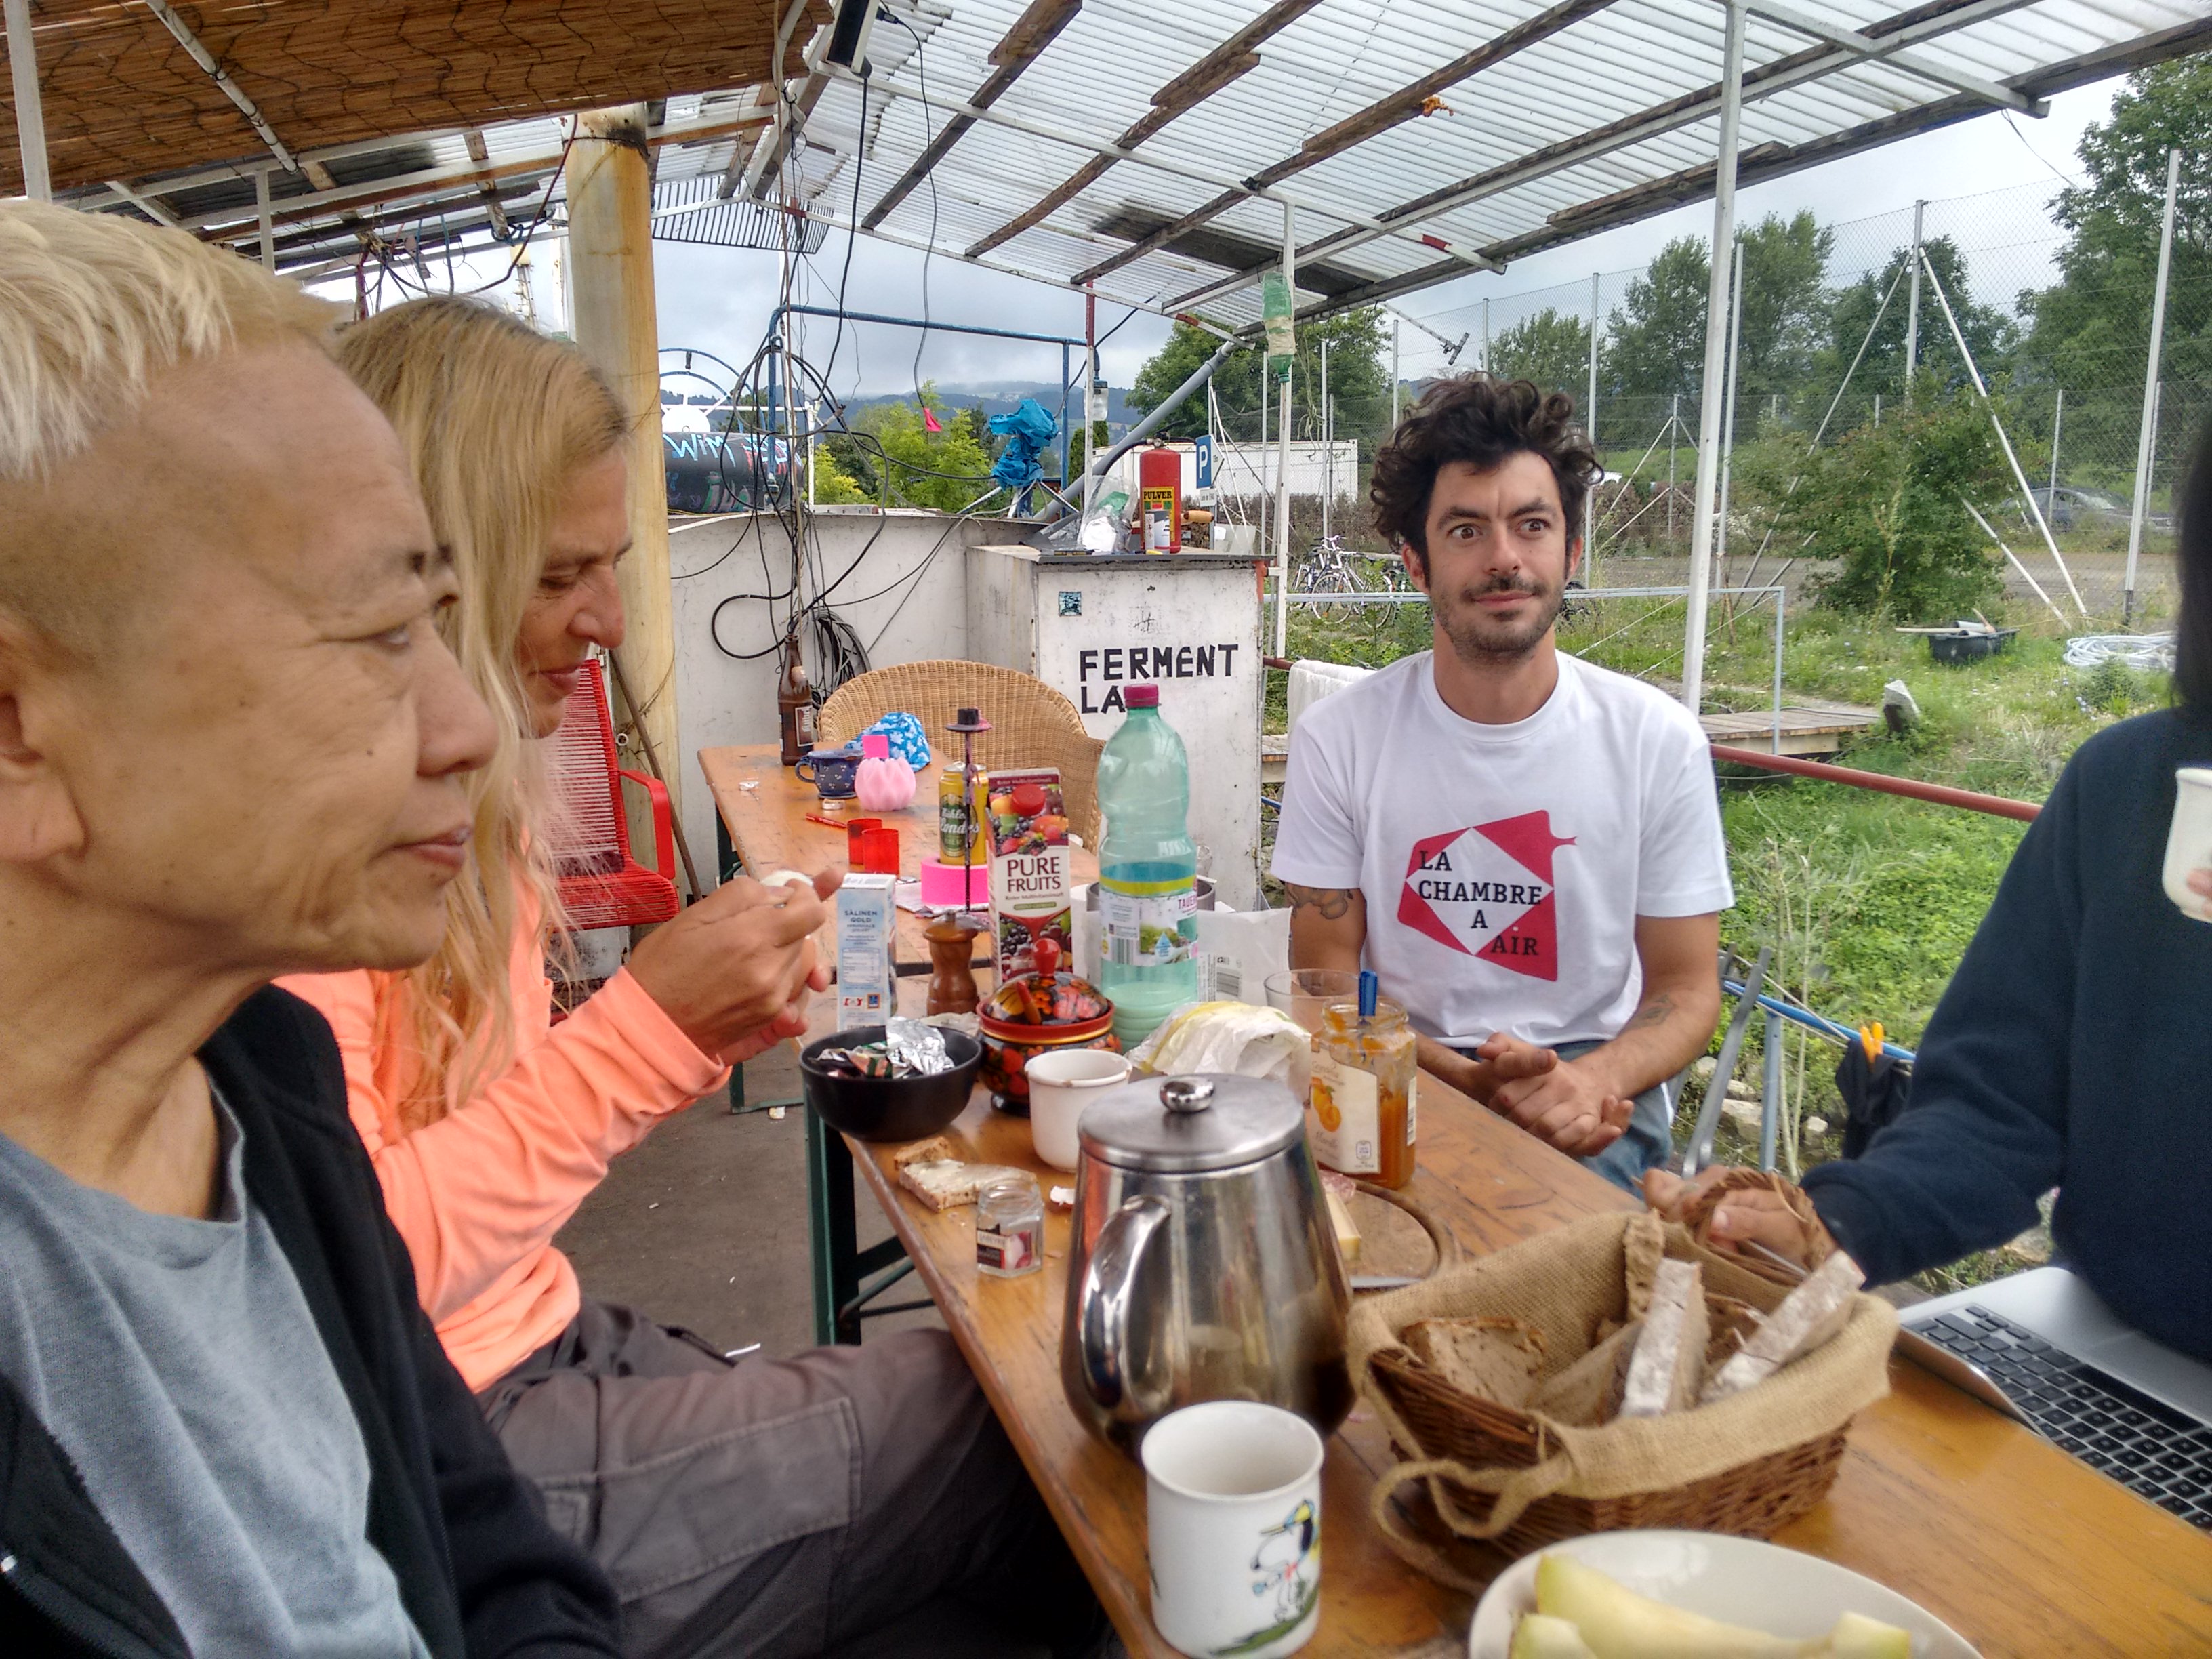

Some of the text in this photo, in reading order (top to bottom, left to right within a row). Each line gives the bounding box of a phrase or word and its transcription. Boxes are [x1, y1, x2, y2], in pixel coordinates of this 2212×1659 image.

[1199, 445, 1208, 480] P
[1143, 491, 1173, 500] PULVER
[1080, 644, 1239, 682] FERMENT
[1007, 857, 1061, 877] PURE
[1418, 850, 1452, 872] LA
[1008, 876, 1061, 893] FRUITS
[1418, 880, 1542, 905] CHAMBRE
[1471, 909, 1488, 929] A
[1490, 935, 1539, 956] AIR
